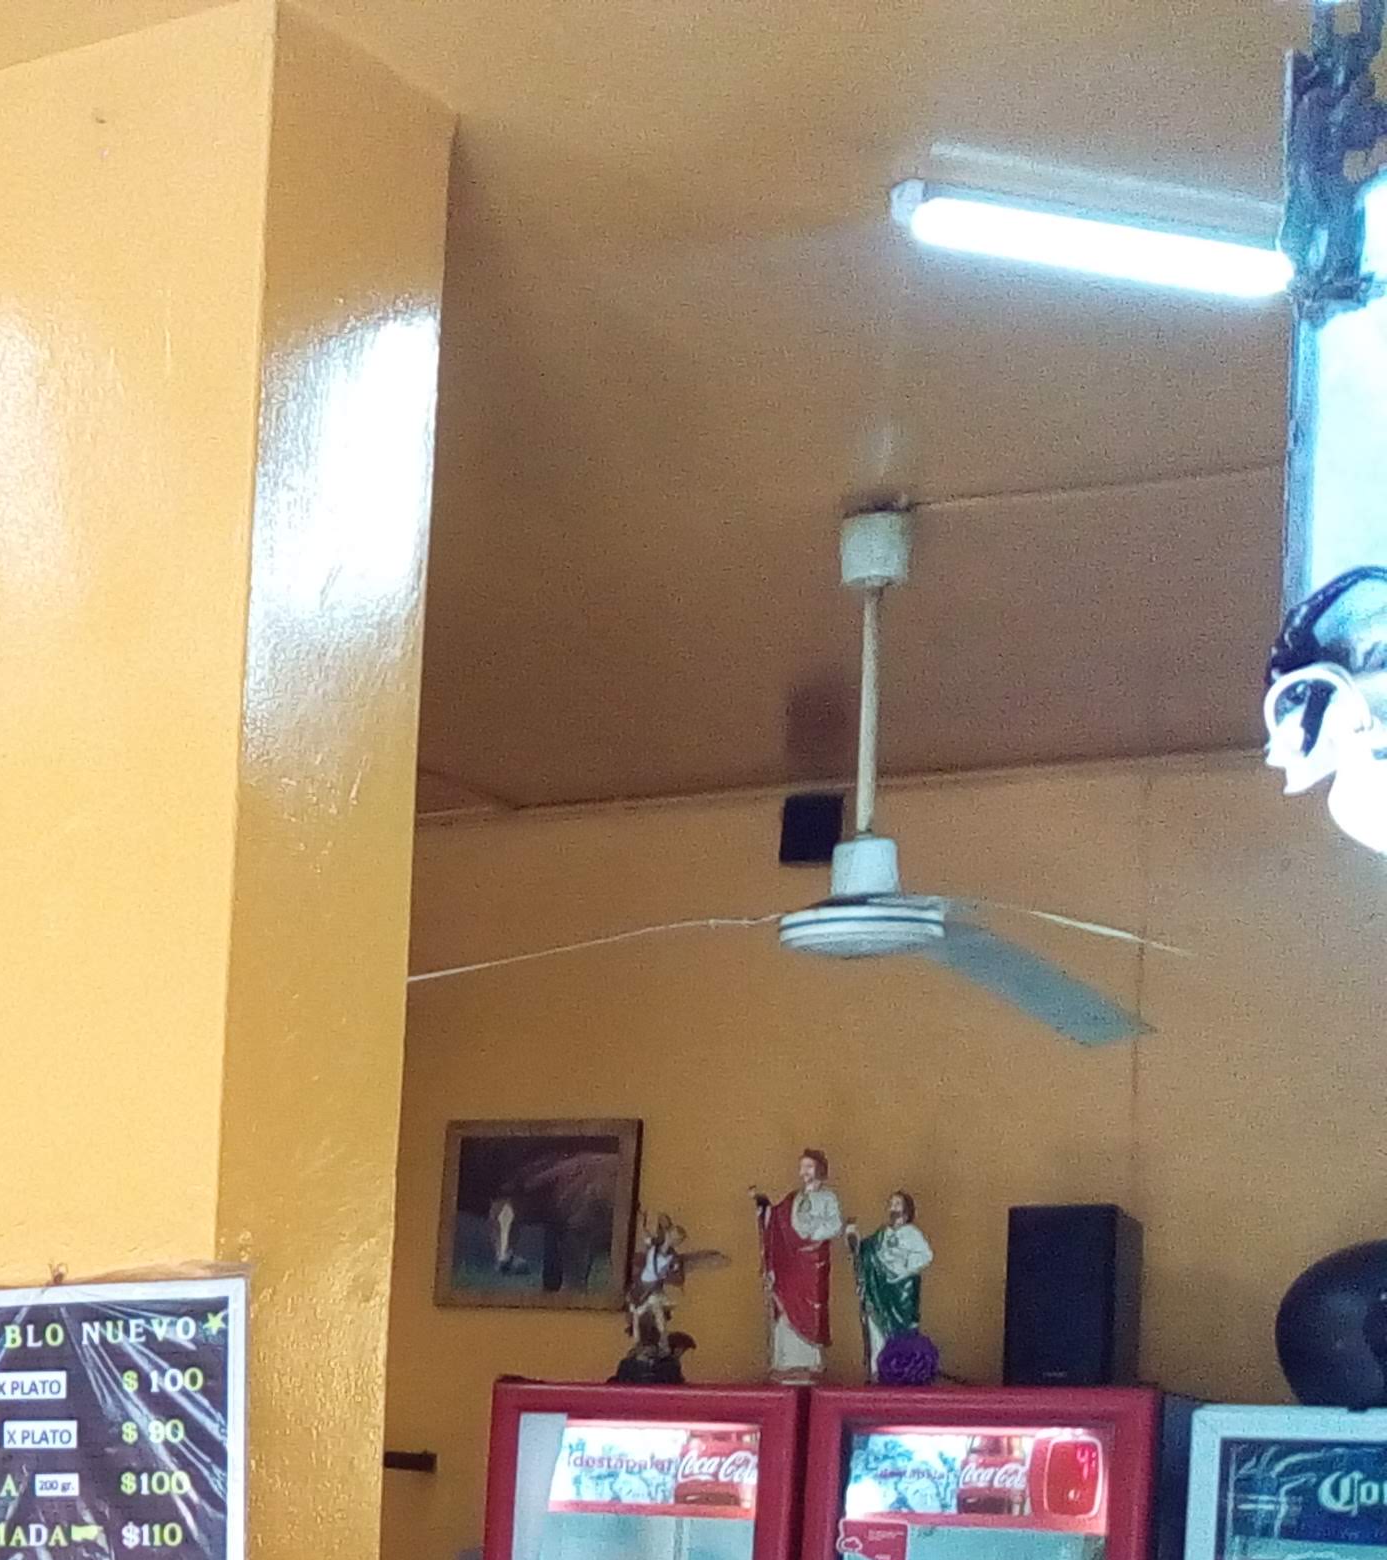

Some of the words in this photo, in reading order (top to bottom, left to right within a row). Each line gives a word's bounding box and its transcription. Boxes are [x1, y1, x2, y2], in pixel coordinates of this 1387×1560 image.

[81, 1316, 197, 1344] NUEVO
[10, 1379, 62, 1397] PLATO
[149, 1366, 204, 1393] 100
[6, 1433, 17, 1446] X
[20, 1428, 73, 1446] PLATO
[149, 1418, 185, 1444] 90
[122, 1522, 183, 1549] $110
